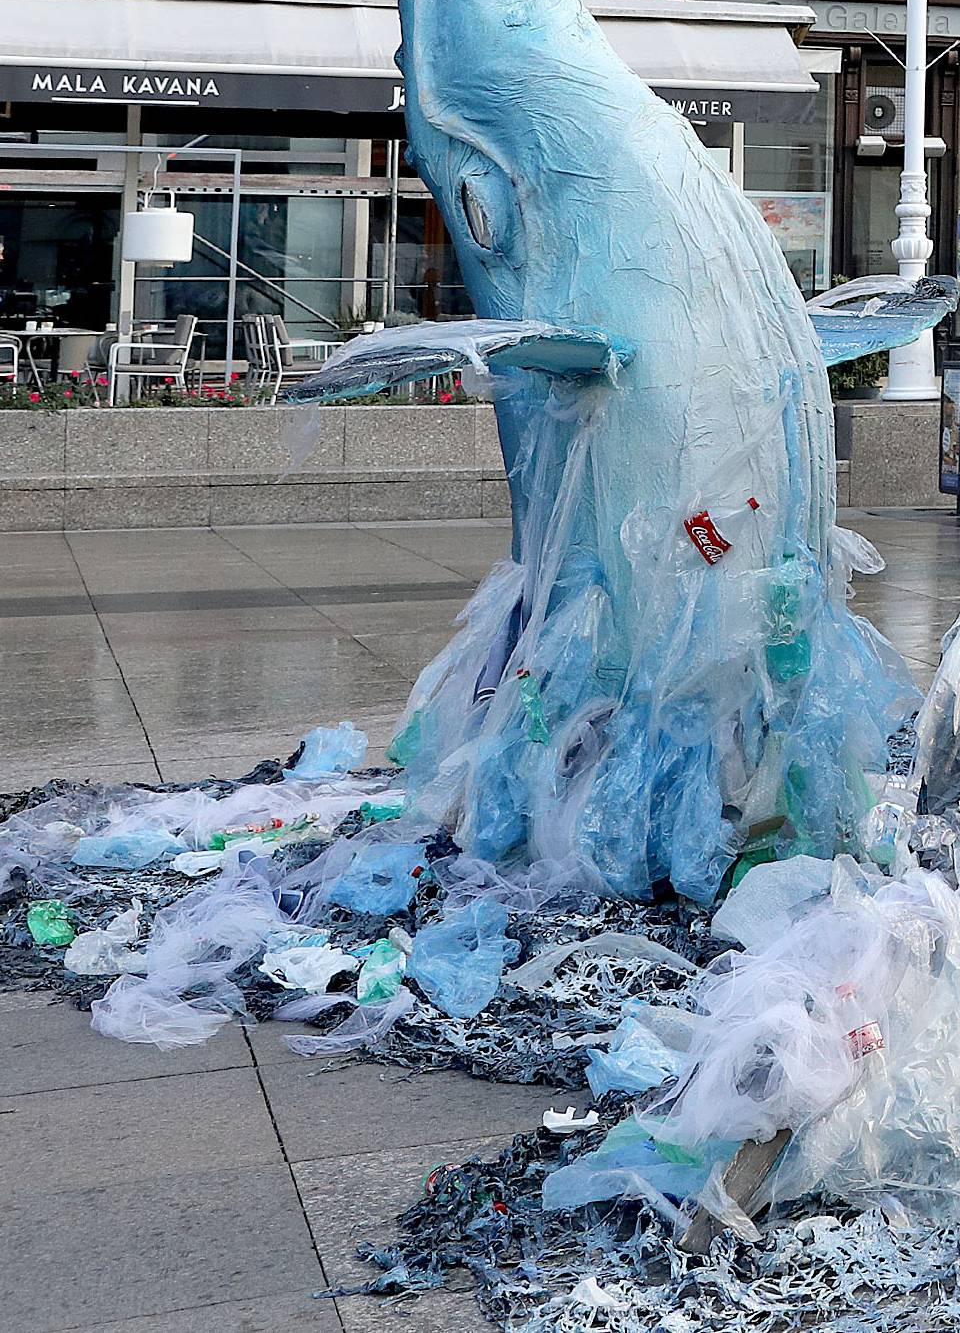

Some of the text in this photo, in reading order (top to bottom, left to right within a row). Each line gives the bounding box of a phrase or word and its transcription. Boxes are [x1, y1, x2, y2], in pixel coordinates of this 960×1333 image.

[31, 73, 220, 97] MALA KAVANA
[671, 99, 732, 116] WATER
